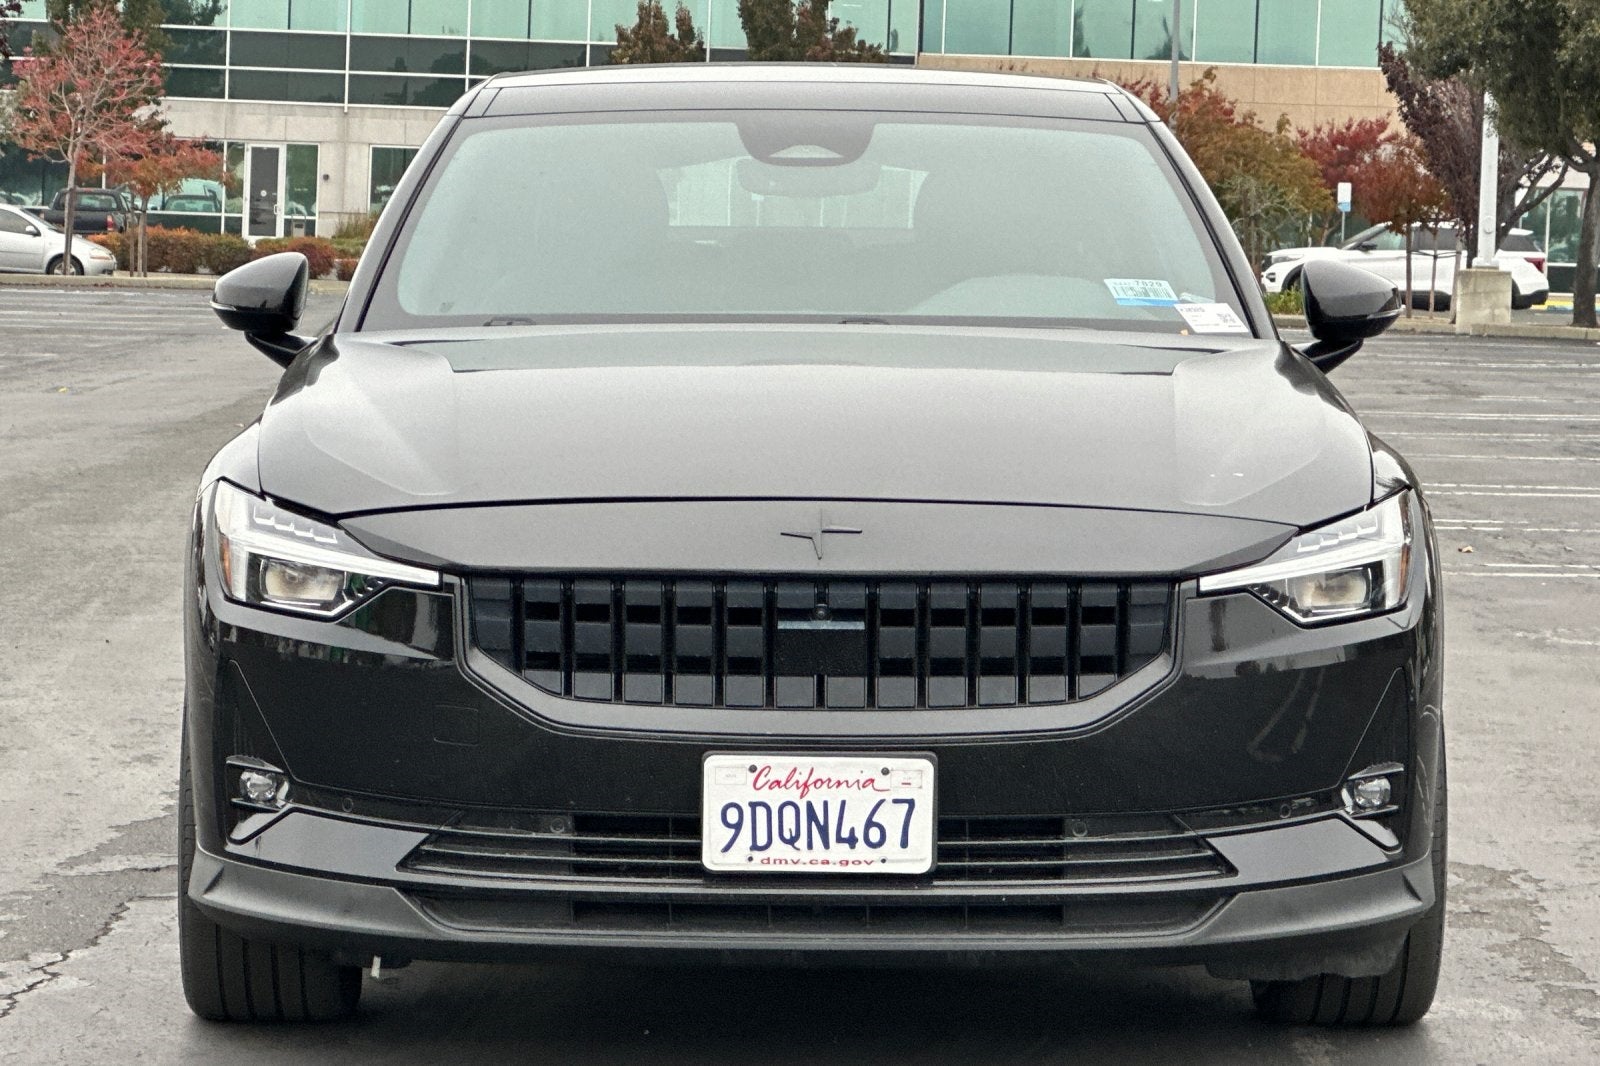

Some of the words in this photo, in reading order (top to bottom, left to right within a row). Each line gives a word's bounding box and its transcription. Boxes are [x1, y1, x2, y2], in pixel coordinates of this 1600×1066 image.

[753, 765, 890, 799] California
[720, 799, 916, 853] 9DQN467
[760, 856, 875, 867] dmv.ca.gov
